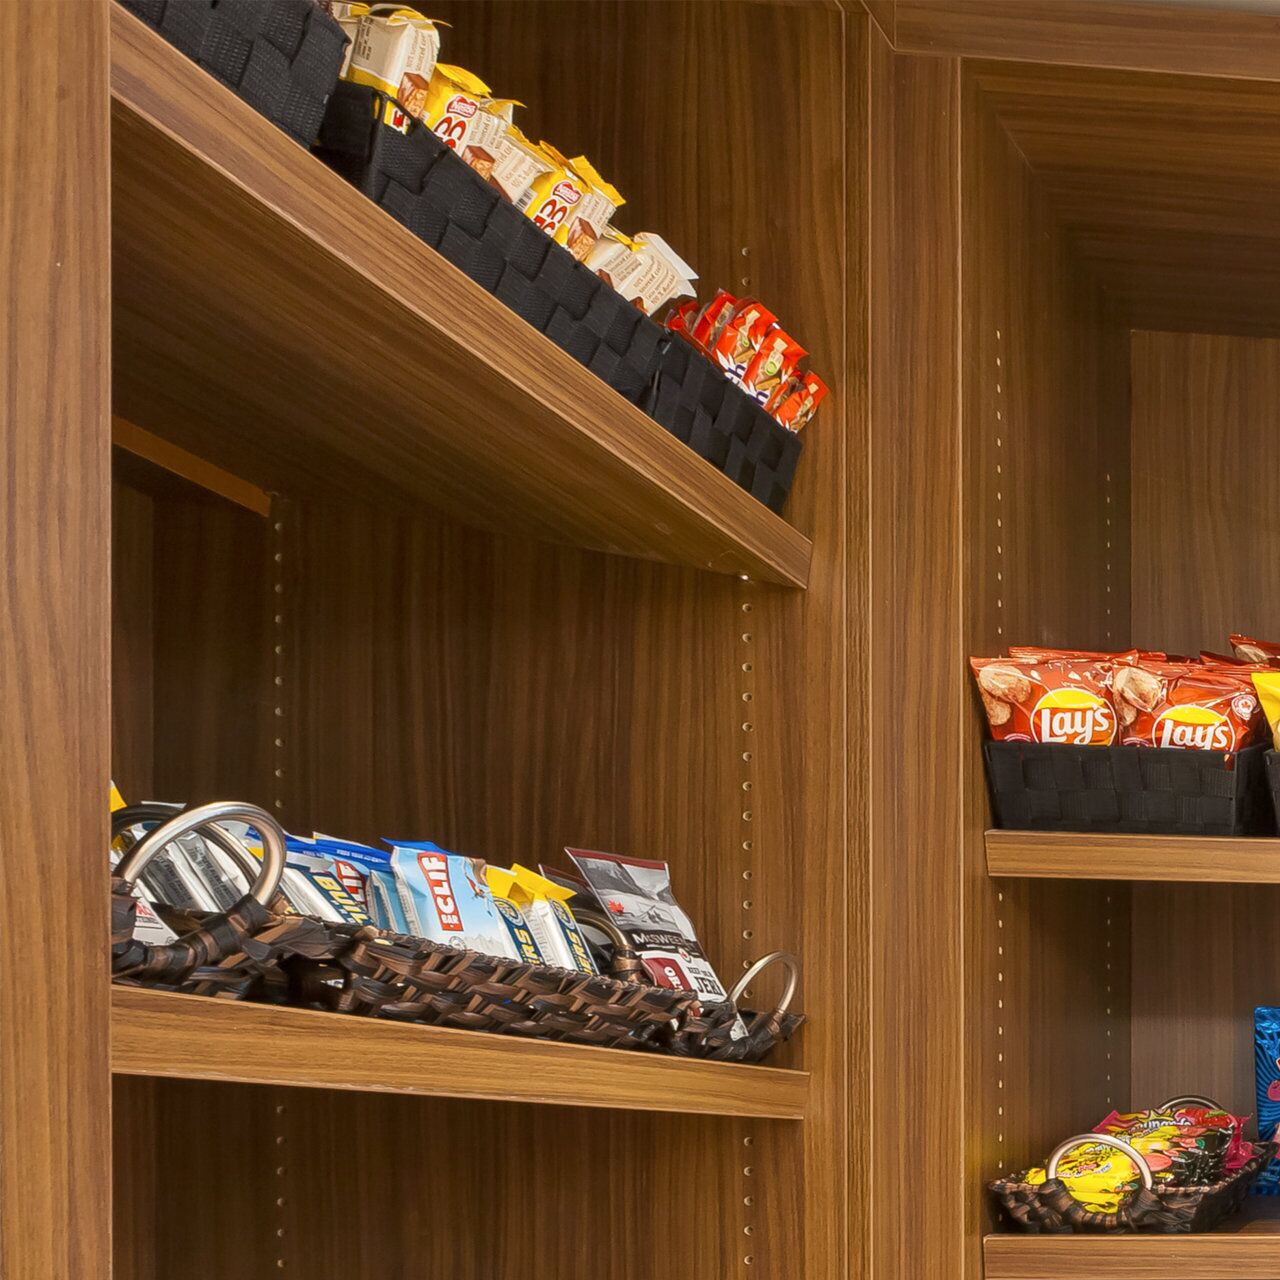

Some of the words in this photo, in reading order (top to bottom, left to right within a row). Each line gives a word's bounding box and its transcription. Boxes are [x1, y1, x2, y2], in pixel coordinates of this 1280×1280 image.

[1041, 704, 1112, 744] Lay's
[1161, 719, 1231, 750] Lay's
[424, 856, 456, 913] CLIF
